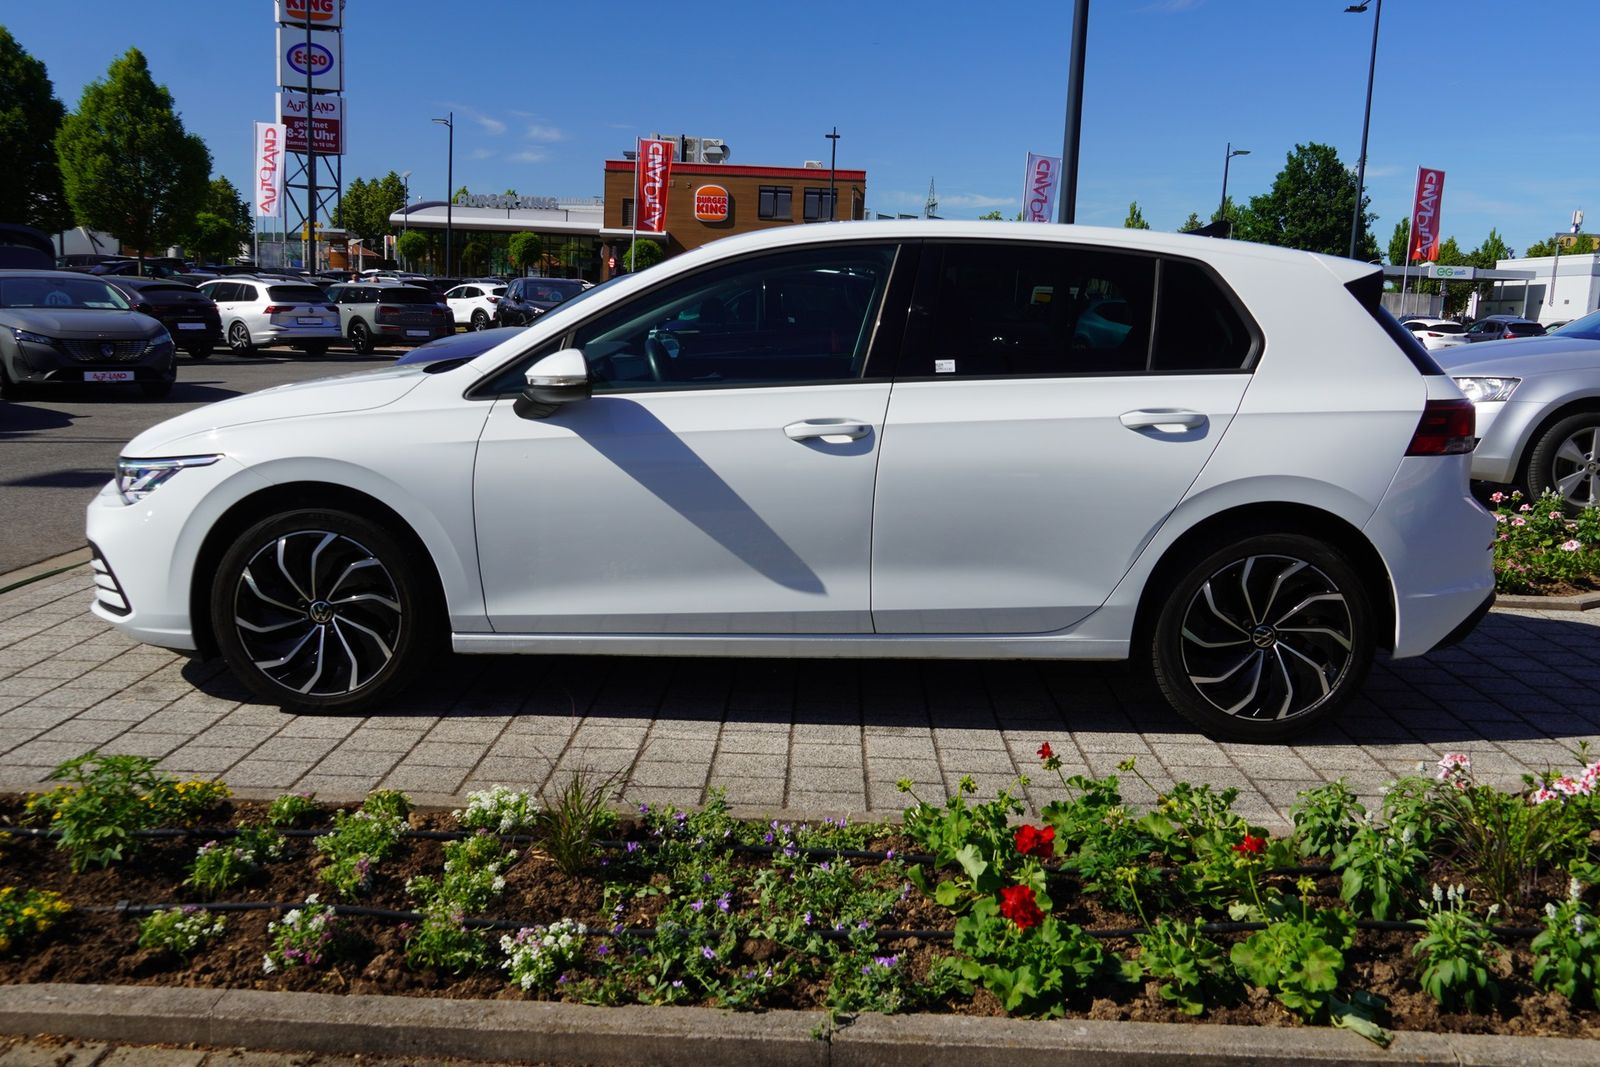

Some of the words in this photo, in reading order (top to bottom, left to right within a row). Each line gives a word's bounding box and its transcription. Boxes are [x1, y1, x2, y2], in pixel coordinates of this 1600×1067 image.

[294, 50, 327, 66] Esso
[313, 130, 336, 141] Uhr
[259, 127, 280, 213] AUTOLAND
[643, 142, 666, 229] AUTOLAND
[696, 196, 727, 205] BURGER
[696, 203, 727, 215] KING
[1416, 171, 1438, 257] AUTOLAND
